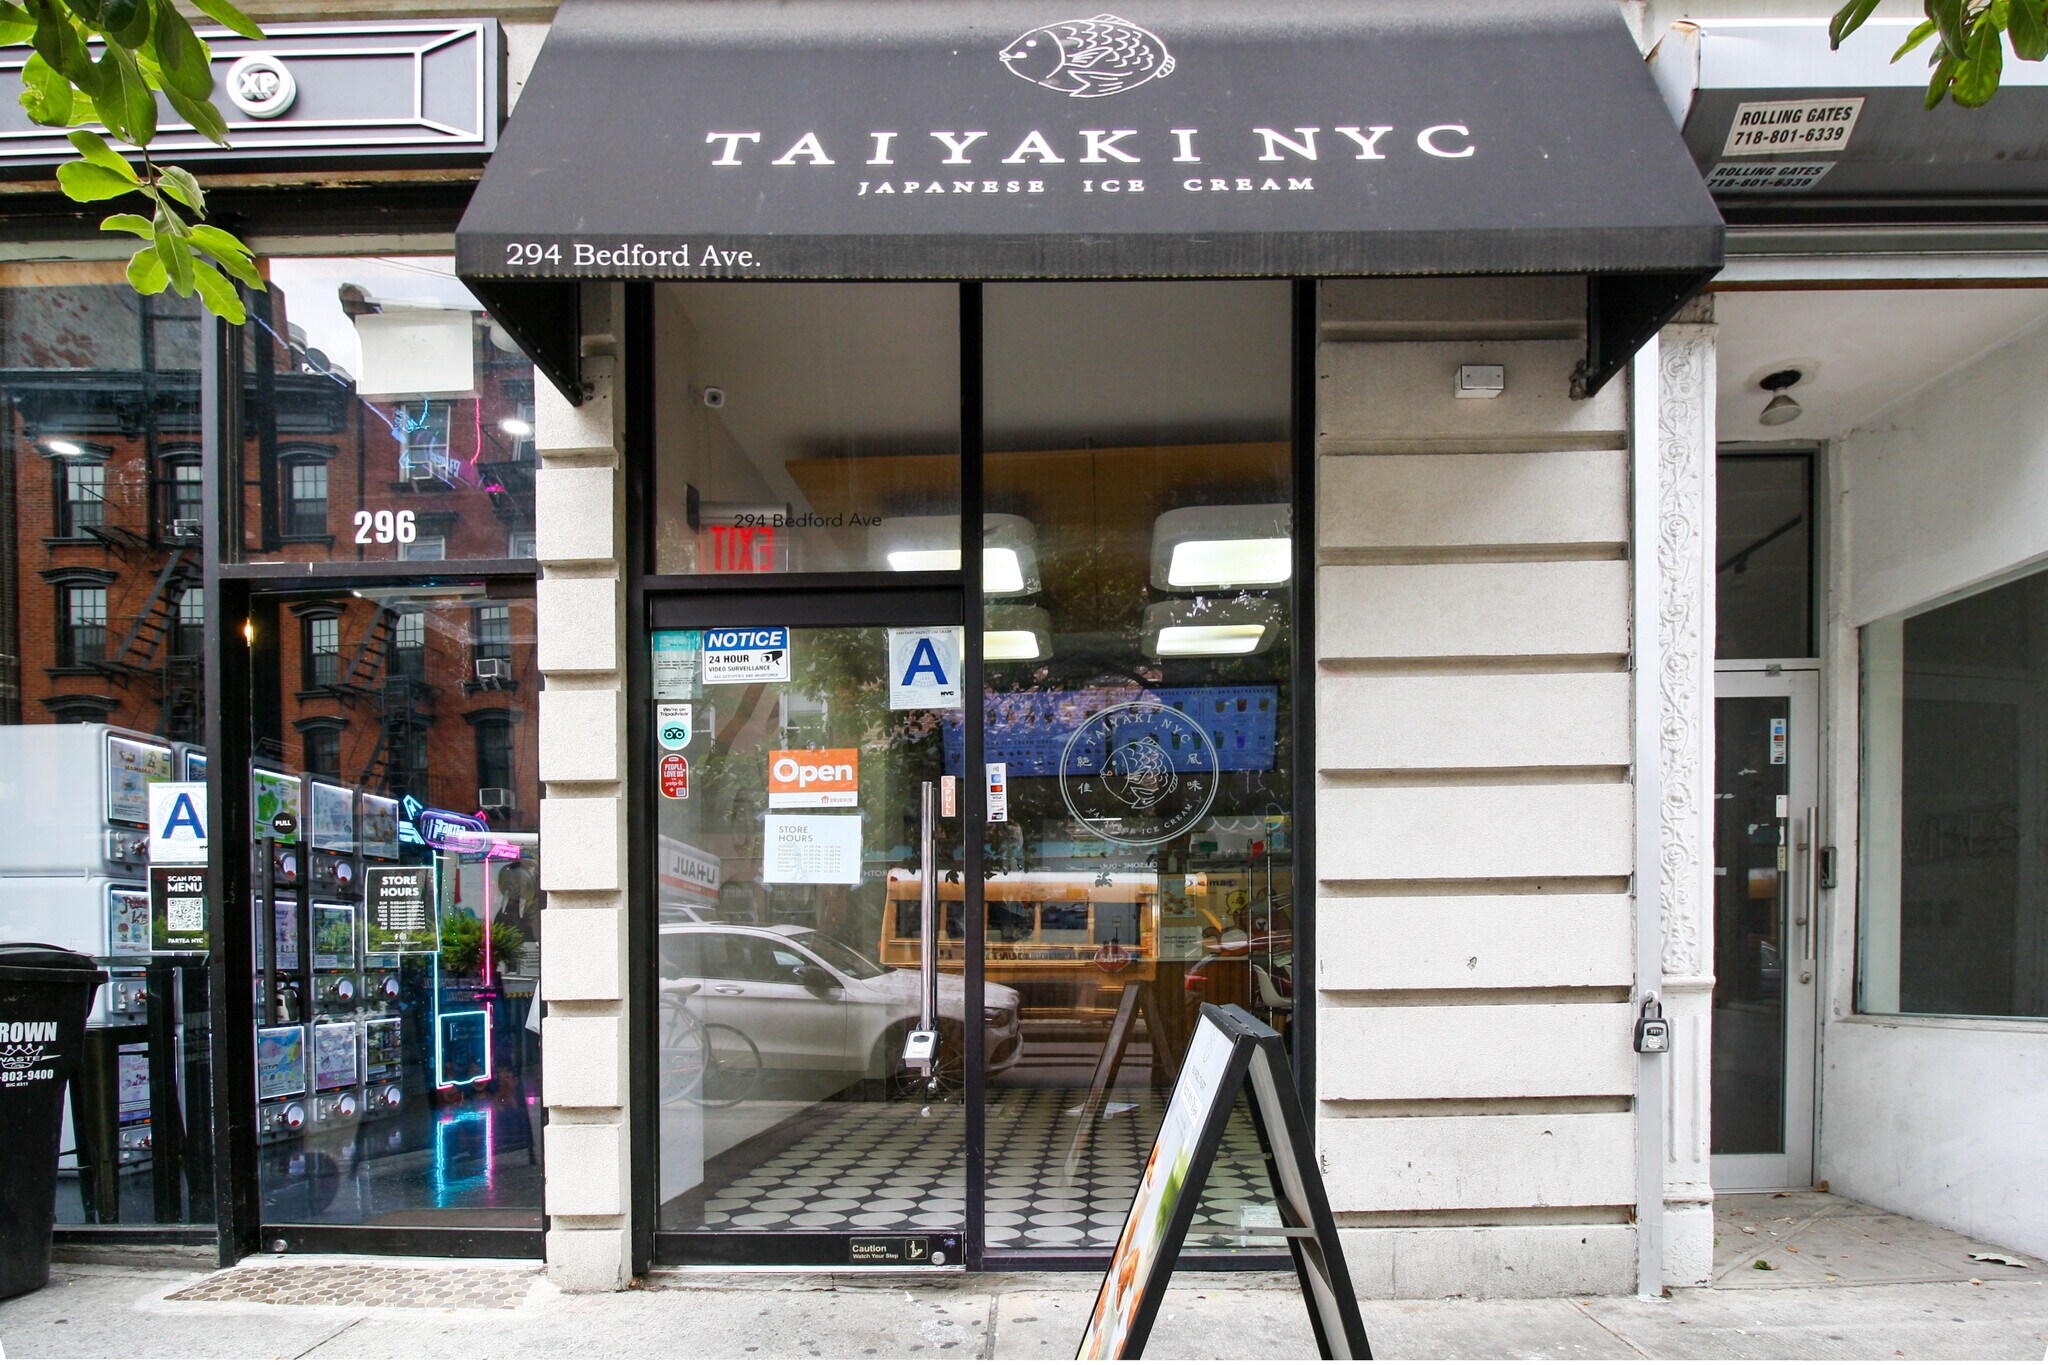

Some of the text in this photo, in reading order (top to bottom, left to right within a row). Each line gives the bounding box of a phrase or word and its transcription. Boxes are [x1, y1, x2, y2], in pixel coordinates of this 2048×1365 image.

[1740, 107, 1853, 126] ROLLING GATES
[705, 124, 1476, 166] TAIYAKI NYC
[1734, 127, 1845, 146] 718-801-6339
[1715, 166, 1825, 177] ROLLING GATES
[857, 177, 1315, 196] JAPANESE ICE CREAM
[1706, 178, 1812, 188] 718-801-6339
[506, 243, 761, 267] 294 Bedford Ave.
[354, 509, 417, 544] 296
[734, 512, 883, 529] 294 Bedford Ave
[708, 630, 783, 649] NOTICE
[708, 654, 750, 664] 24 HOUR
[901, 637, 948, 686] A
[1085, 713, 1191, 747] TAIYAKI NYC
[773, 758, 853, 788] Open
[162, 792, 207, 839] A
[275, 819, 292, 827] PULL
[1141, 826, 1160, 835] ICE
[1163, 803, 1193, 829] CREAM
[778, 825, 808, 834] STORE
[778, 834, 814, 843] HOURS
[167, 882, 203, 893] MENU
[381, 875, 418, 886] STORE
[380, 887, 420, 897] HOURS
[851, 1244, 887, 1253] Caution
